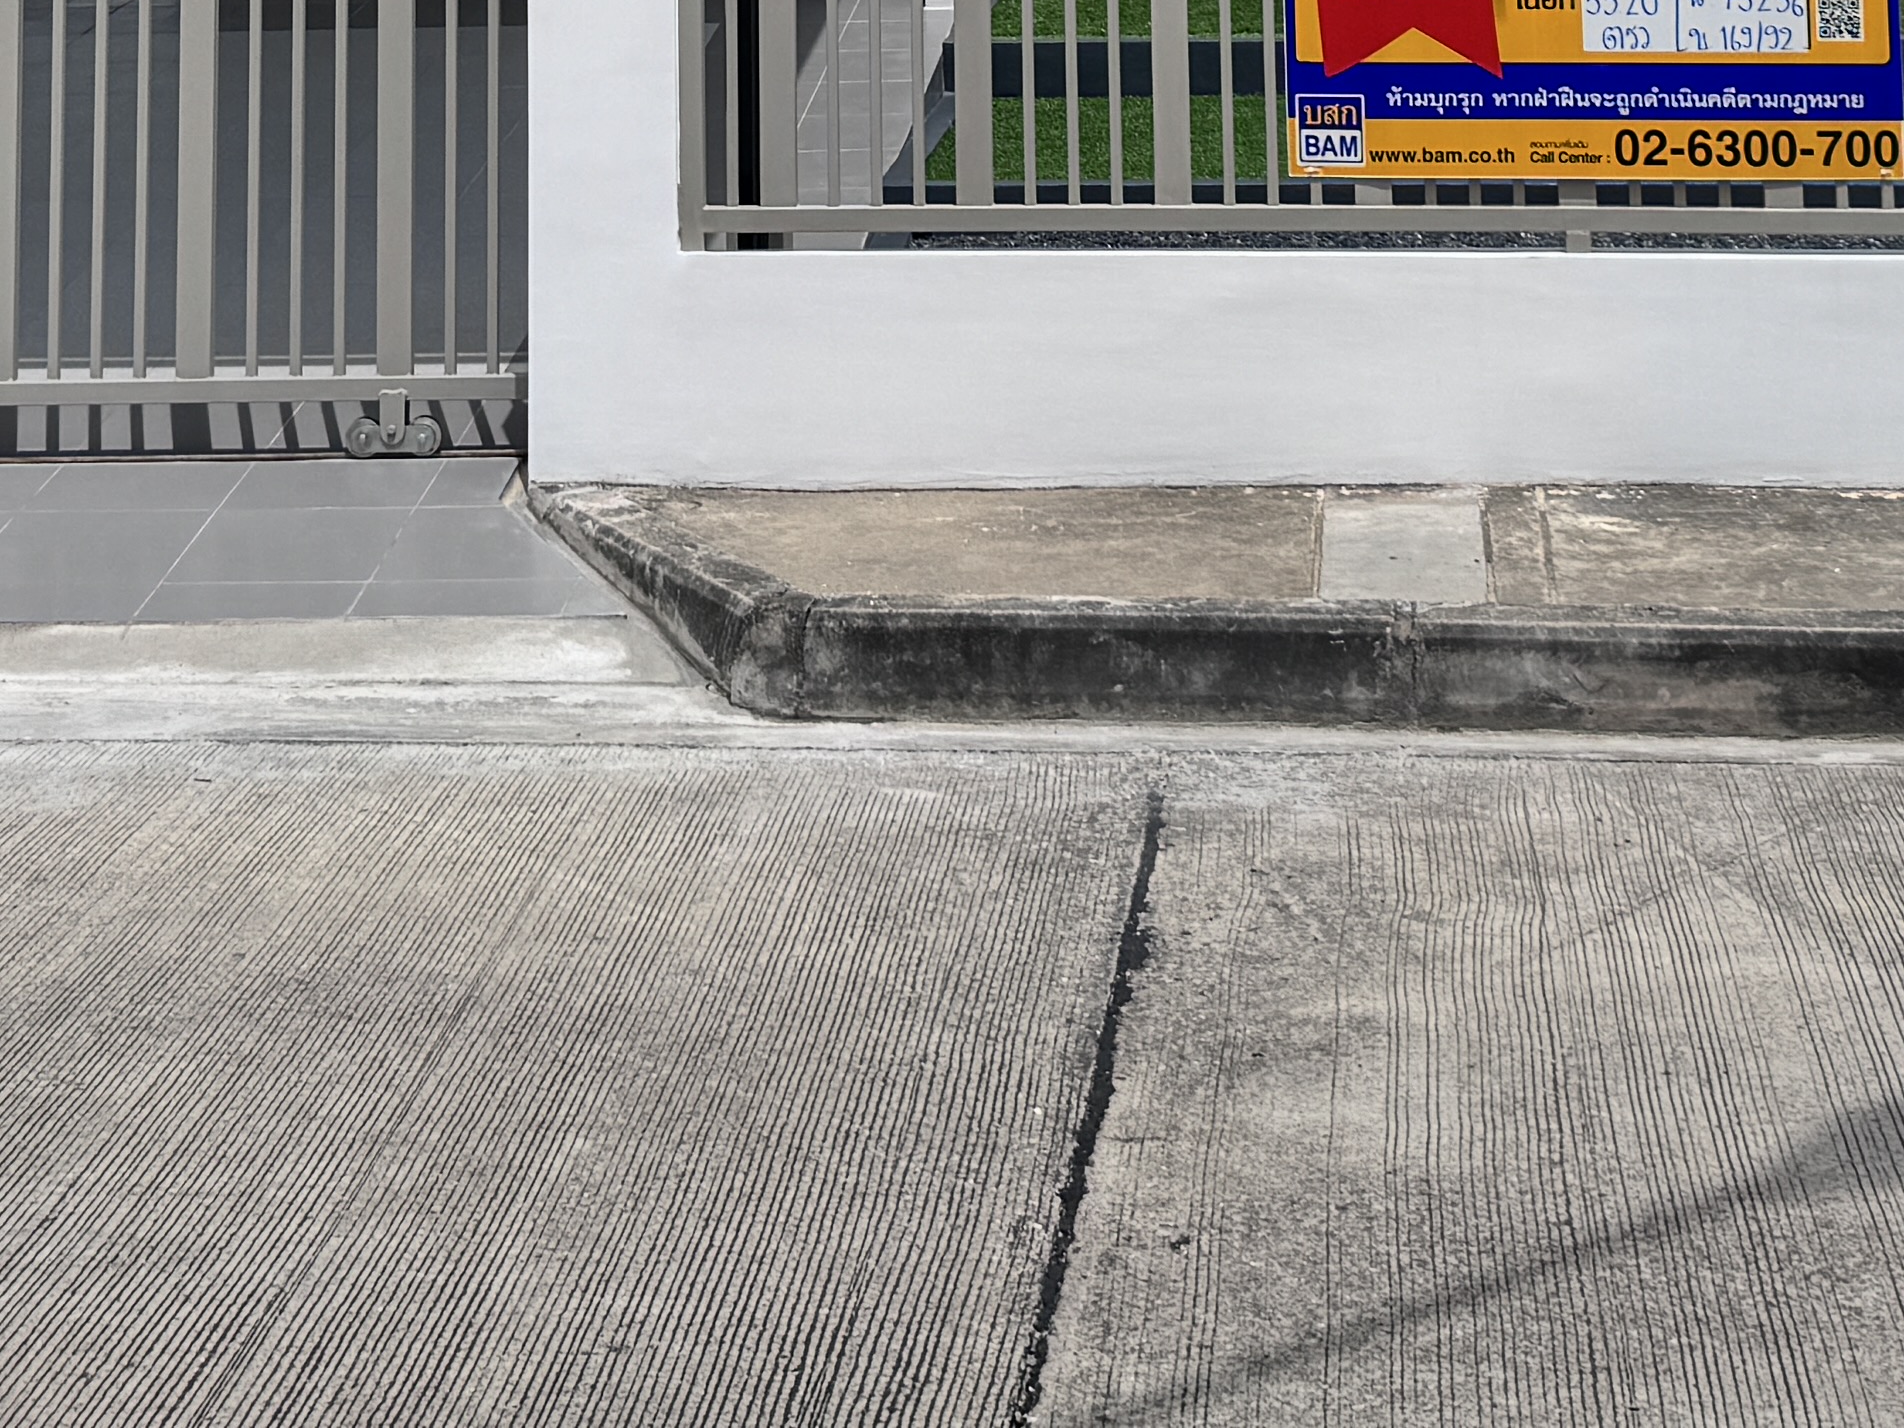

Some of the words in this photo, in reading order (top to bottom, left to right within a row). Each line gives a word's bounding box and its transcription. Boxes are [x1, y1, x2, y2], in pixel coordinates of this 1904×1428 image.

[1720, 20, 1793, 53] 169/92
[1385, 86, 1483, 115] ห้ามบุกรุก
[1303, 103, 1357, 126] บสก
[1304, 134, 1358, 158] BAM
[1369, 147, 1515, 164] www.bam.co.th
[1529, 150, 1555, 163] Call
[1558, 151, 1603, 163] Center
[1614, 129, 1900, 168] 02-6300-700
